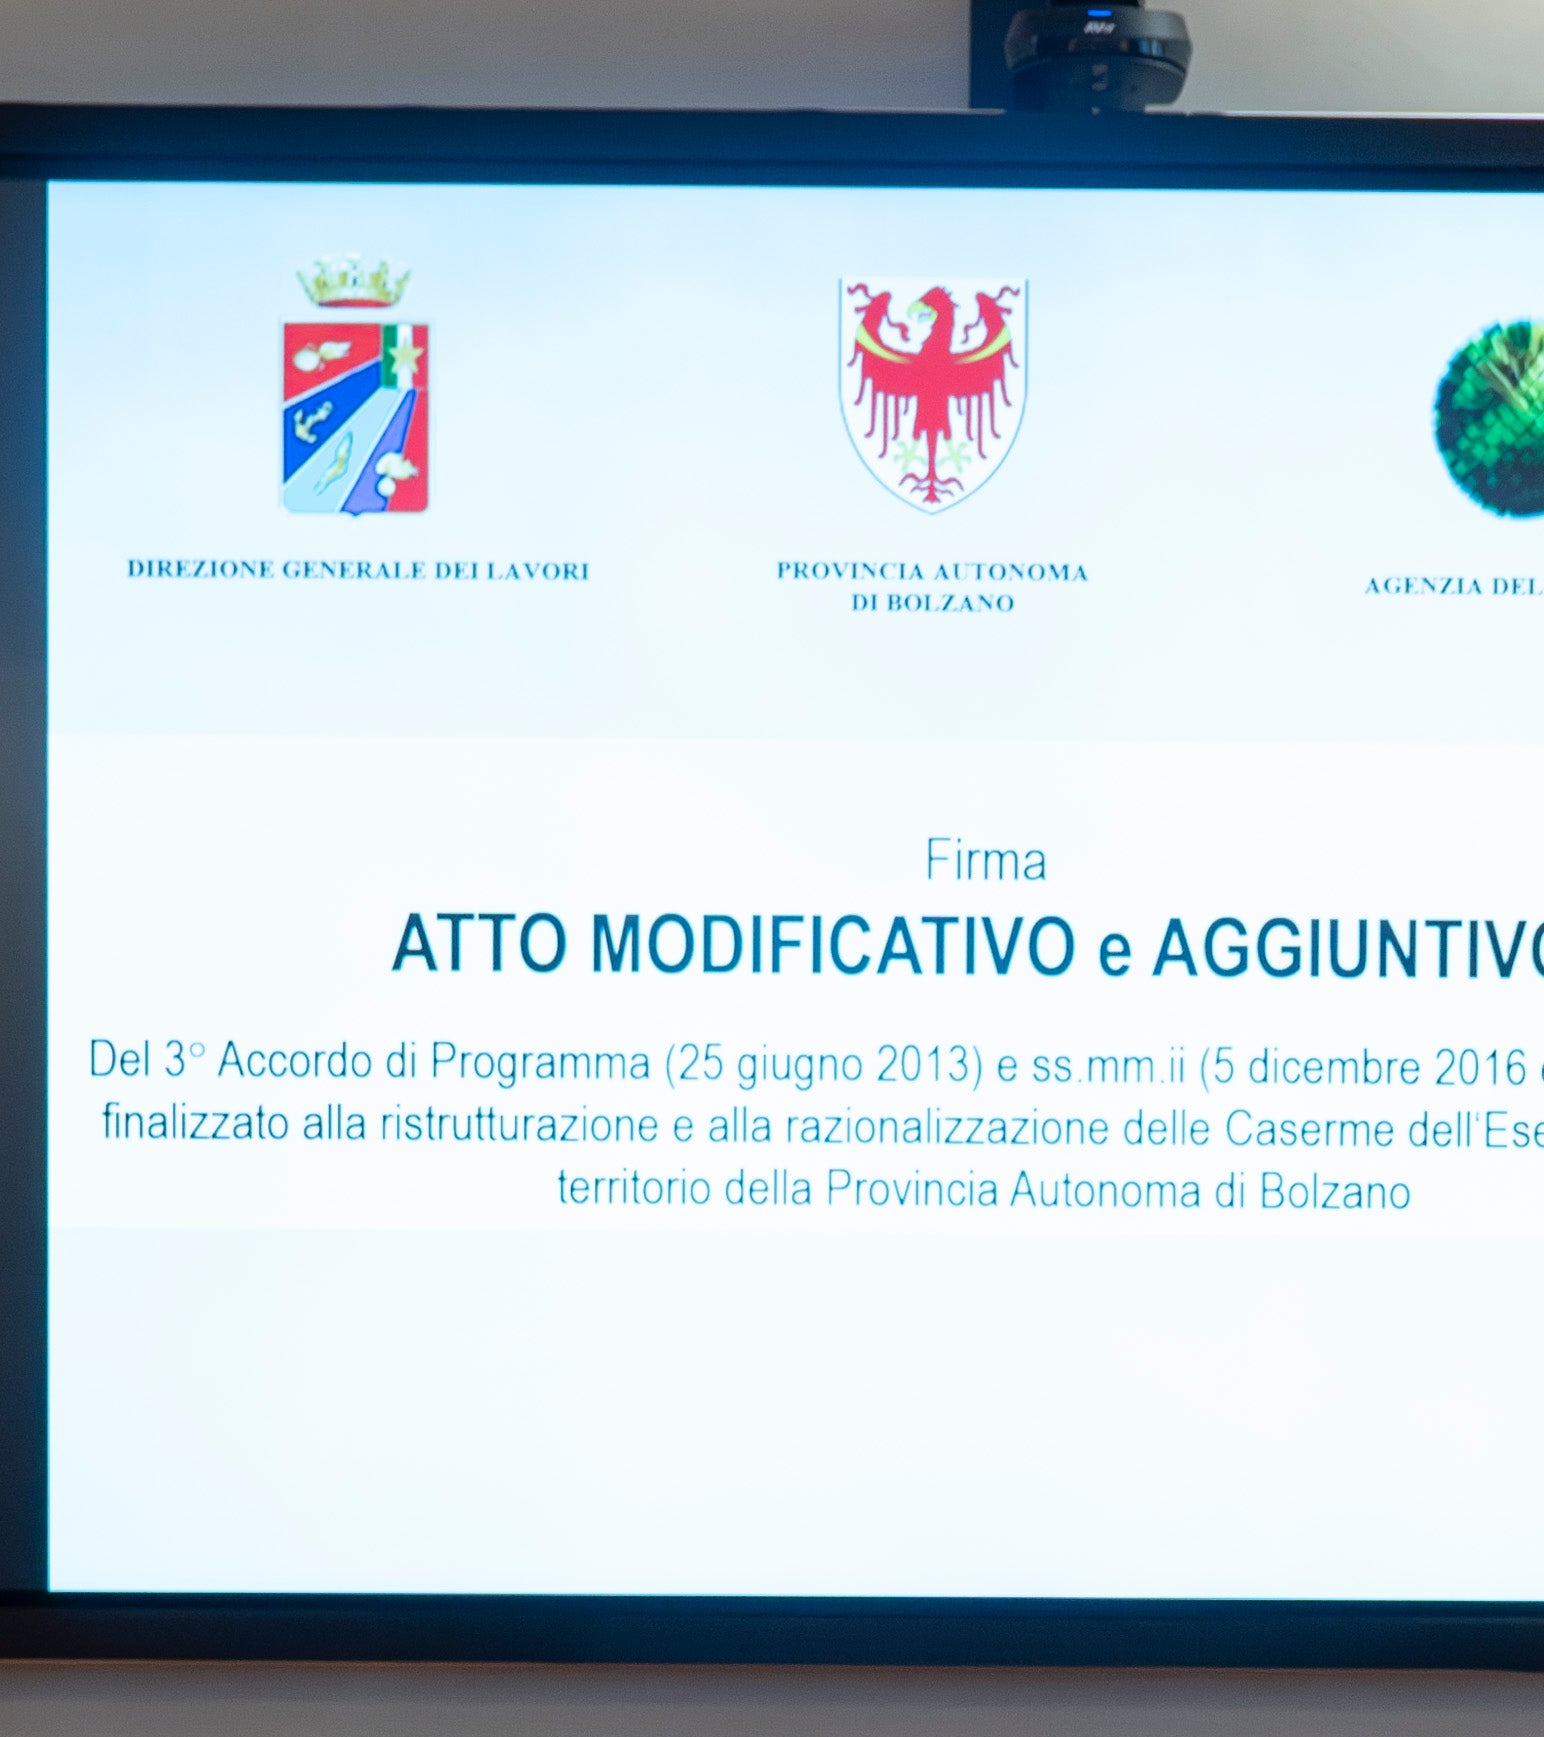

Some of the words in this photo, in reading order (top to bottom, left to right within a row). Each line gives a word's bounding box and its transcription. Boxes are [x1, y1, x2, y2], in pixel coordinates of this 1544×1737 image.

[127, 557, 275, 580] DIREZIONE
[281, 559, 427, 581] GENERALE
[434, 560, 479, 581] DEI
[486, 560, 590, 582] LAVORI
[776, 560, 926, 582] PROVINCIA
[933, 561, 1089, 583] AUTONOMA
[1364, 575, 1484, 596] AGENZIA
[1491, 576, 1544, 597] DEL
[850, 592, 879, 613] DI
[886, 592, 1016, 614] BOLZANO
[926, 835, 1047, 882] Firma
[390, 910, 569, 976] ATTO
[591, 911, 1077, 979] MODIFICATIVO
[1097, 930, 1134, 979] e
[89, 1036, 151, 1079] Del
[216, 1038, 374, 1080] Accordo
[385, 1039, 417, 1080] di
[431, 1039, 651, 1091] Programma
[664, 1041, 725, 1091] (25
[736, 1042, 864, 1093] giugno
[876, 1042, 984, 1093] 2013)
[996, 1053, 1019, 1084] e
[1031, 1045, 1185, 1085] ss.mm.ii
[1199, 1044, 1235, 1094] (5
[1247, 1045, 1422, 1087] dicembre
[1434, 1046, 1528, 1088] 2016
[100, 1100, 290, 1142] finalizzato
[302, 1102, 367, 1142] alla
[380, 1102, 660, 1144] ristrutturazione
[672, 1114, 695, 1144] e
[707, 1104, 773, 1145] alla
[786, 1105, 1110, 1147] razionalizzazione
[1122, 1107, 1211, 1147] delle
[1225, 1107, 1396, 1149] Caserme
[556, 1166, 712, 1206] territorio
[724, 1167, 813, 1207] della
[827, 1167, 999, 1208] Provincia
[1008, 1168, 1202, 1210] Autonoma
[1214, 1170, 1246, 1210] di
[1260, 1170, 1412, 1211] Bolzano
